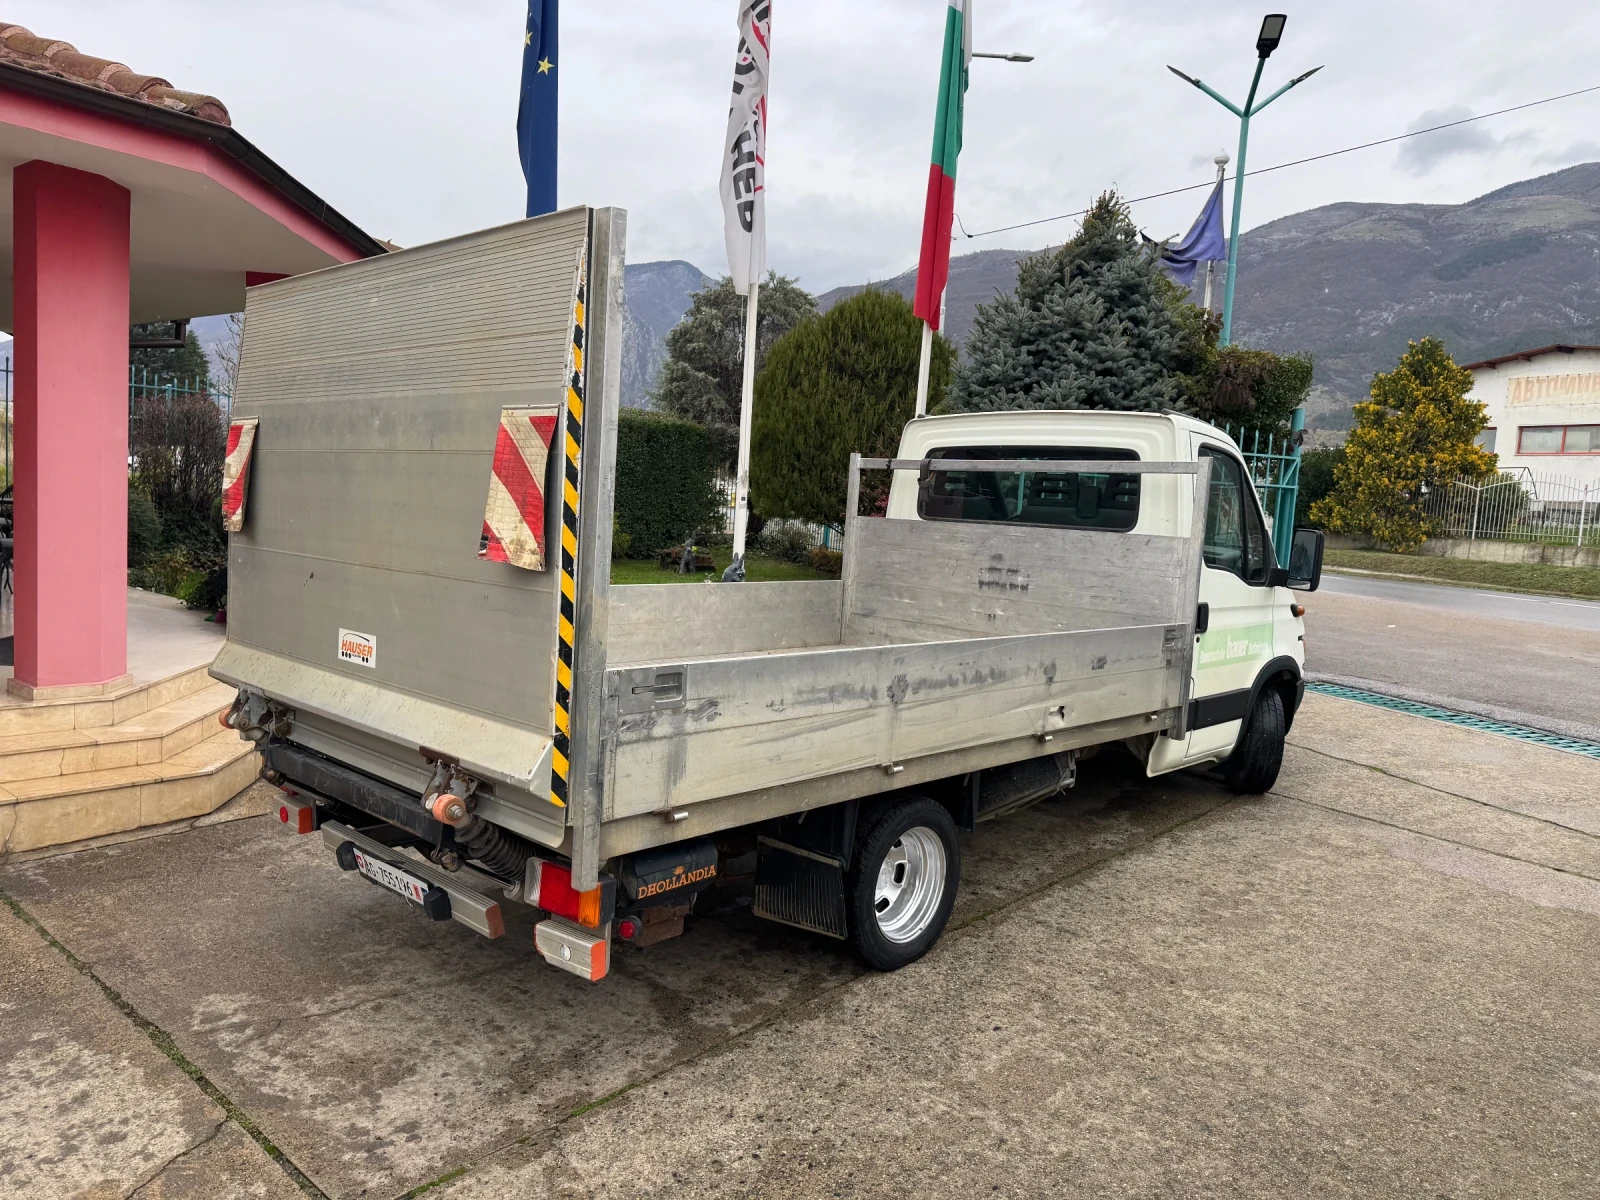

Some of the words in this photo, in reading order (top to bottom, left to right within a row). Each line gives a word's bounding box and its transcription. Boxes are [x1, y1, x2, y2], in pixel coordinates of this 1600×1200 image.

[341, 639, 373, 658] HAUSER
[1226, 634, 1249, 659] bauer
[637, 864, 717, 900] DHOLLANDIA
